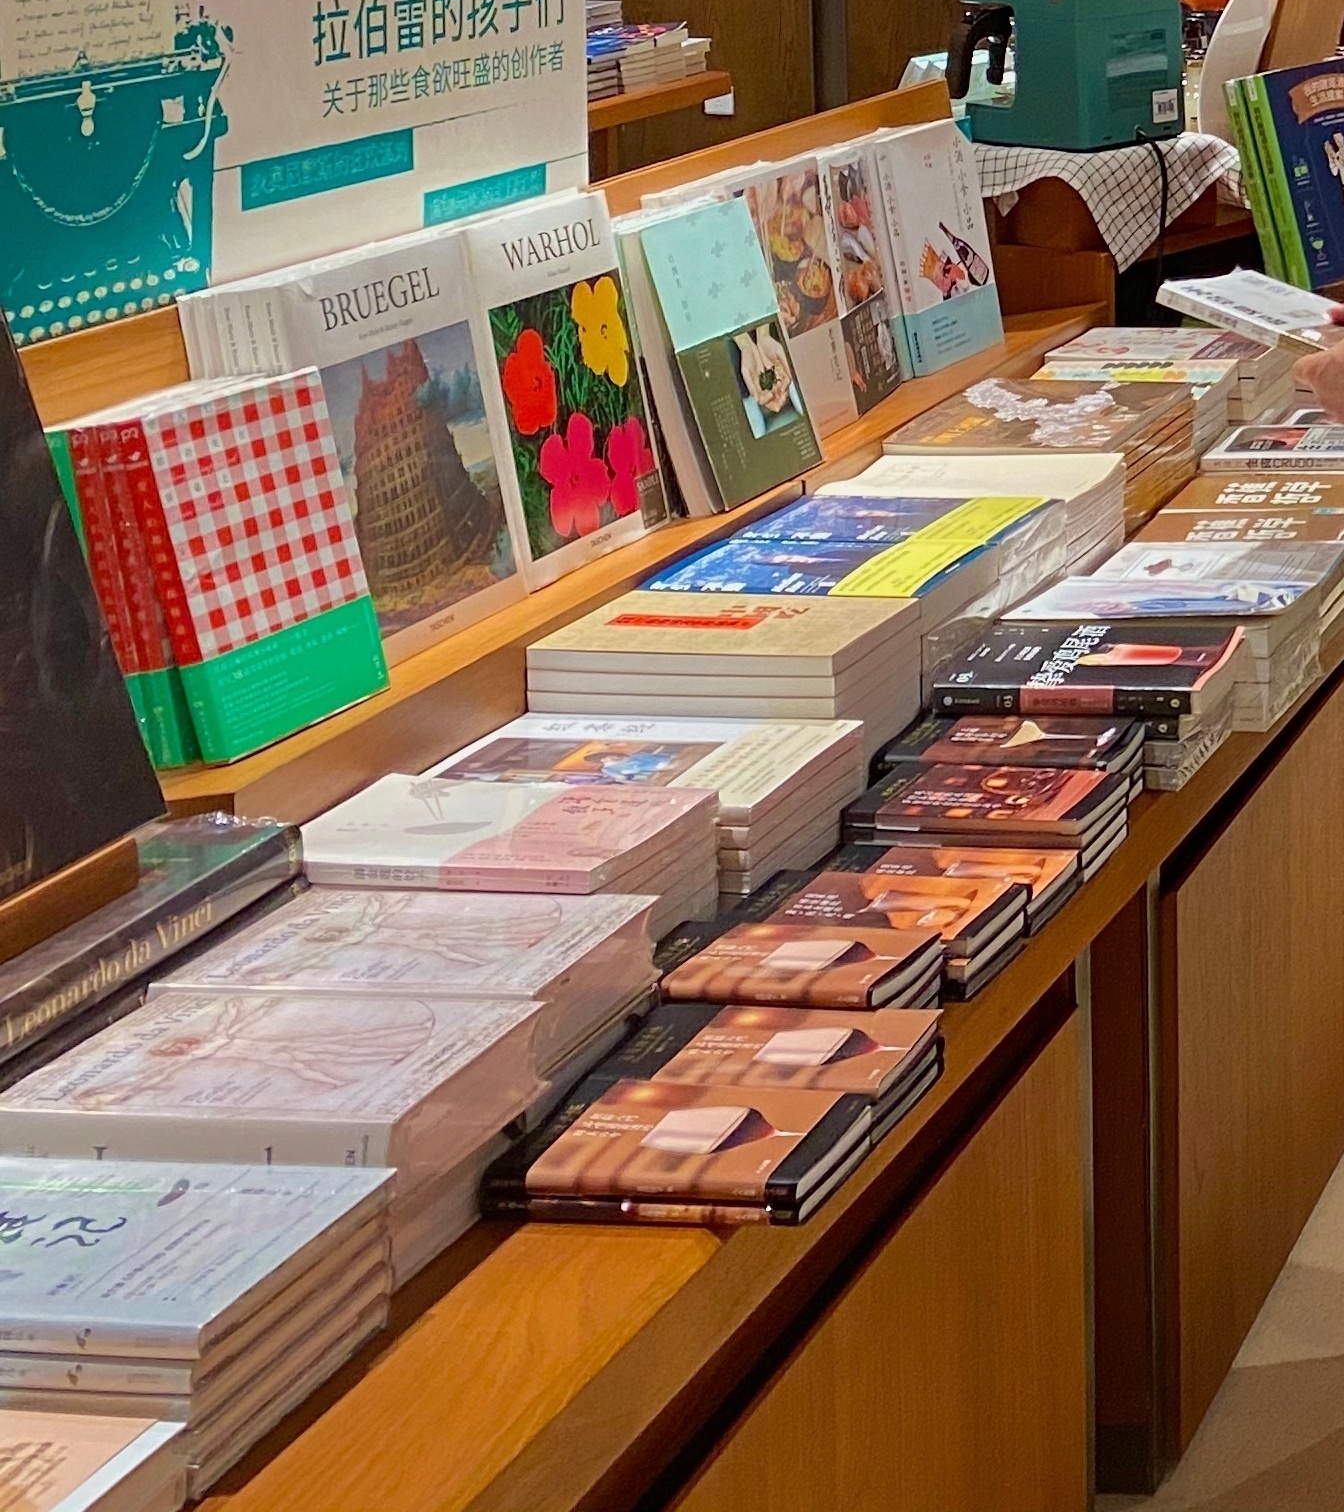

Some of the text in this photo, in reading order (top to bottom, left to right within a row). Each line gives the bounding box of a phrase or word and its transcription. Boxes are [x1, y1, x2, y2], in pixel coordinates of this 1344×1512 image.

[322, 39, 565, 119] 关于那些食欲旺盛的创作者
[501, 218, 601, 272] WARHOL
[319, 266, 440, 333] BRUEGEL
[2, 896, 213, 1047] Leonardo da Vinci
[36, 1034, 144, 1103] Leonardo
